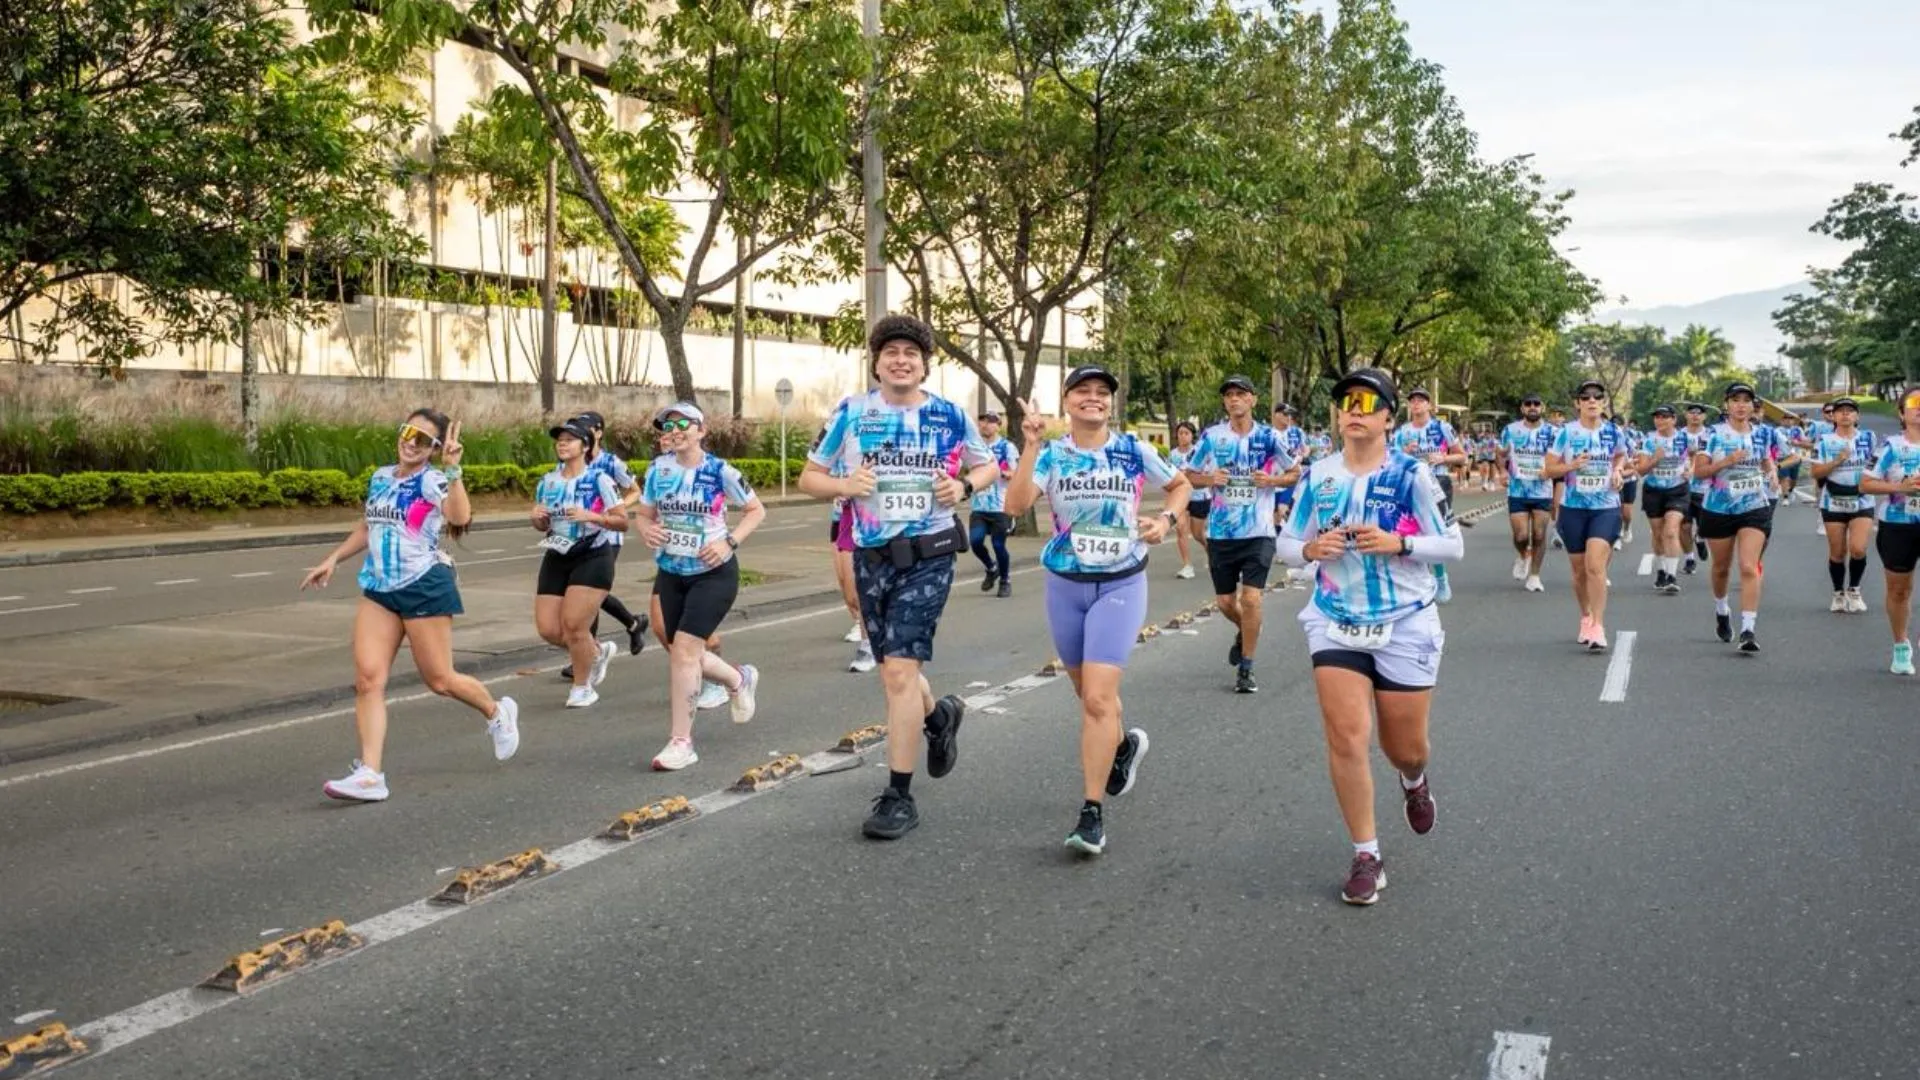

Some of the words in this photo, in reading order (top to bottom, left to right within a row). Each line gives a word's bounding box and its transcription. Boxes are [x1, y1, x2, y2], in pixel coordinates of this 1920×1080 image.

[884, 494, 927, 510] 5143
[1365, 498, 1397, 514] epm
[1076, 537, 1121, 556] 5144
